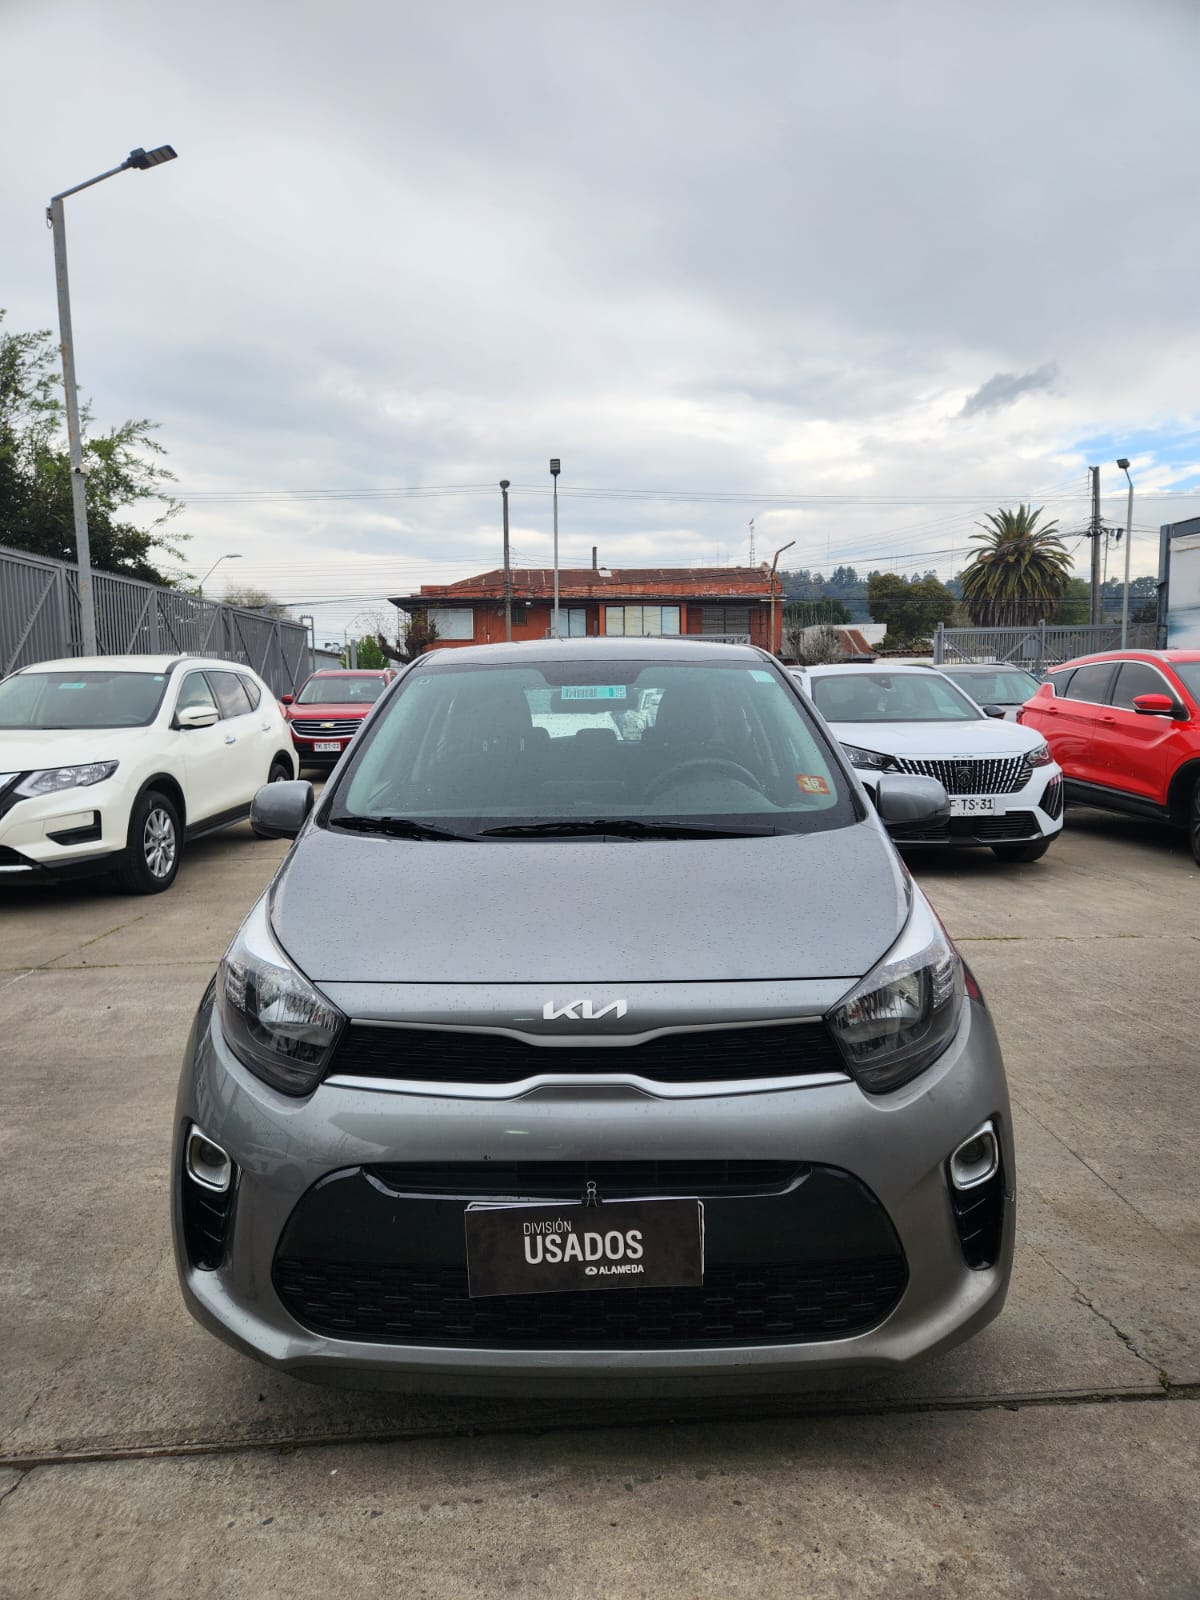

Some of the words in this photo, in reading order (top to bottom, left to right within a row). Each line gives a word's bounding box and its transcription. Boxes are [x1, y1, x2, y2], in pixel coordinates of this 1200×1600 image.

[543, 999, 627, 1020] KIA
[523, 1218, 572, 1235] DIVISIÓN
[524, 1230, 644, 1264] USADOS
[598, 1264, 645, 1275] ALAMEDA
